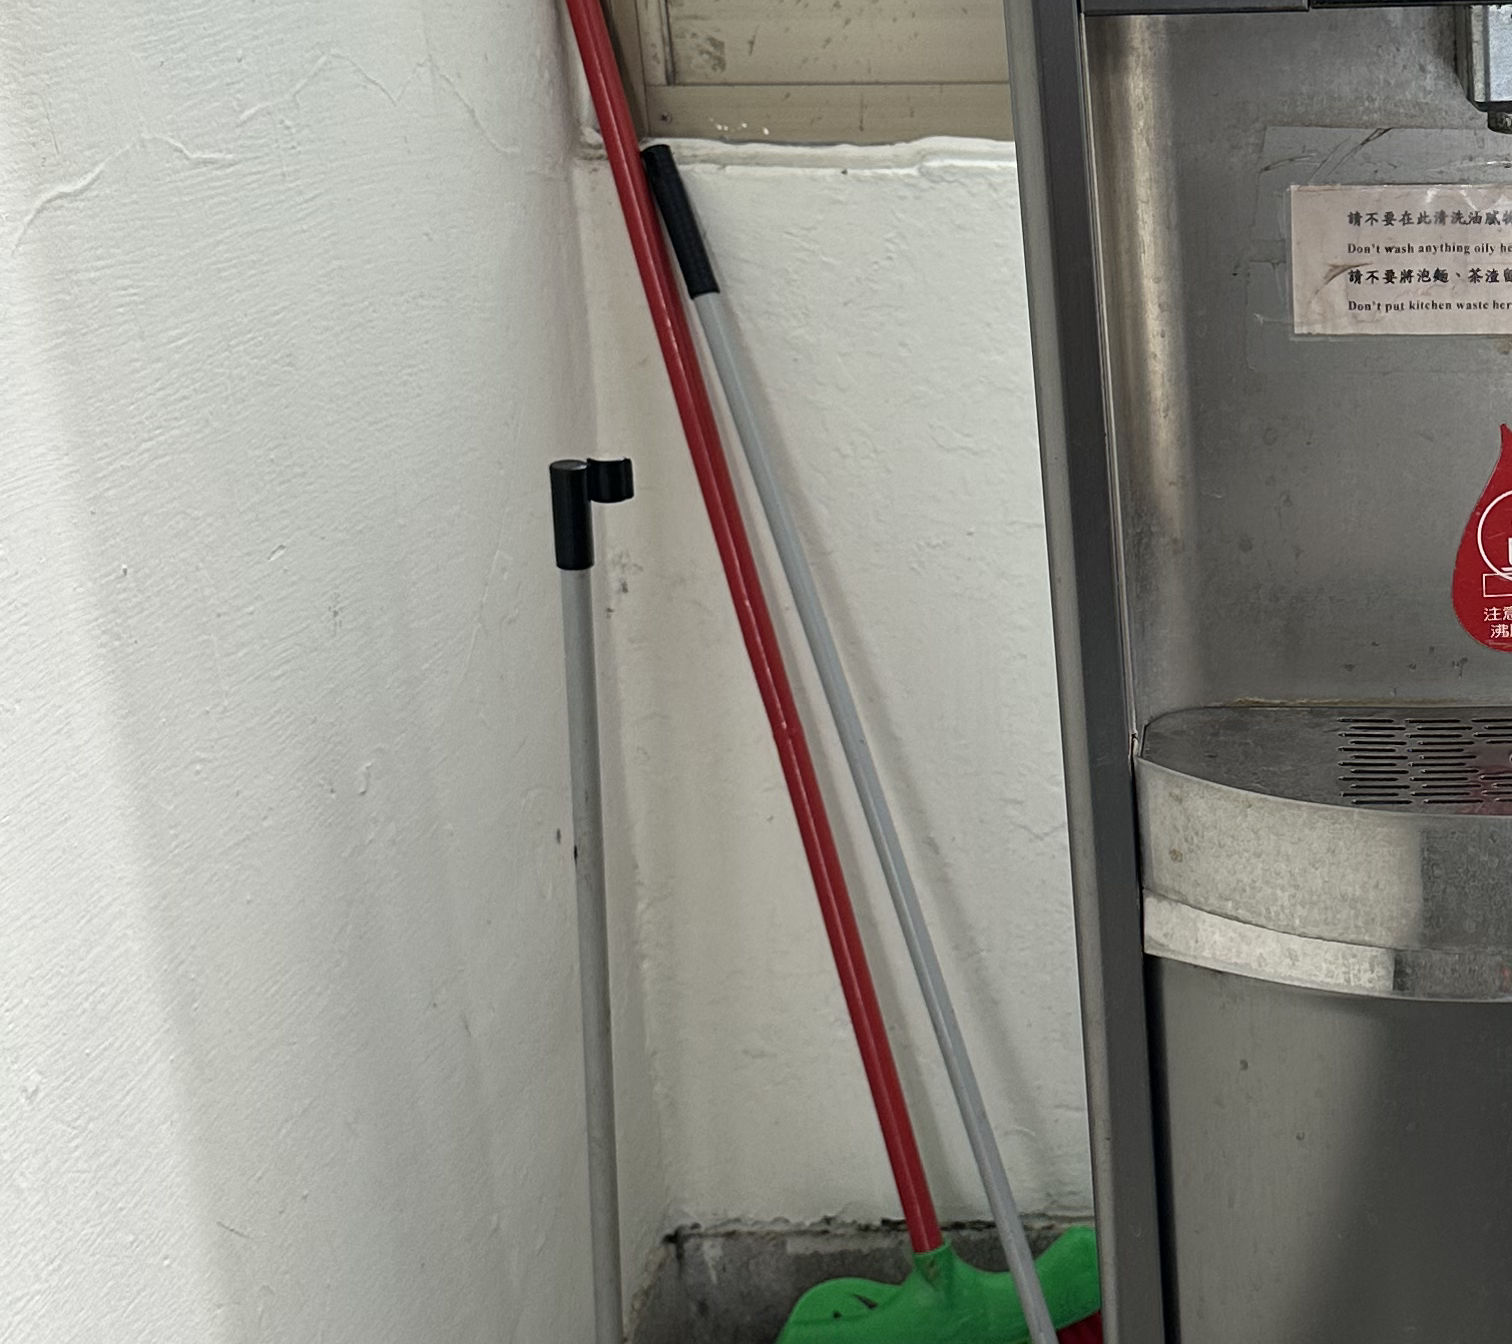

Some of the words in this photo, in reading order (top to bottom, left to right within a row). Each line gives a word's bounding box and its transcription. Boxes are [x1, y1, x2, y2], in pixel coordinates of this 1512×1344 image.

[1347, 242, 1381, 254] Don't
[1384, 243, 1414, 254] wash
[1418, 243, 1470, 256] anything
[1474, 242, 1495, 256] oily
[1348, 300, 1381, 311] Don't
[1385, 301, 1405, 313] put
[1409, 299, 1452, 310] kitchen
[1456, 301, 1488, 310] waste
